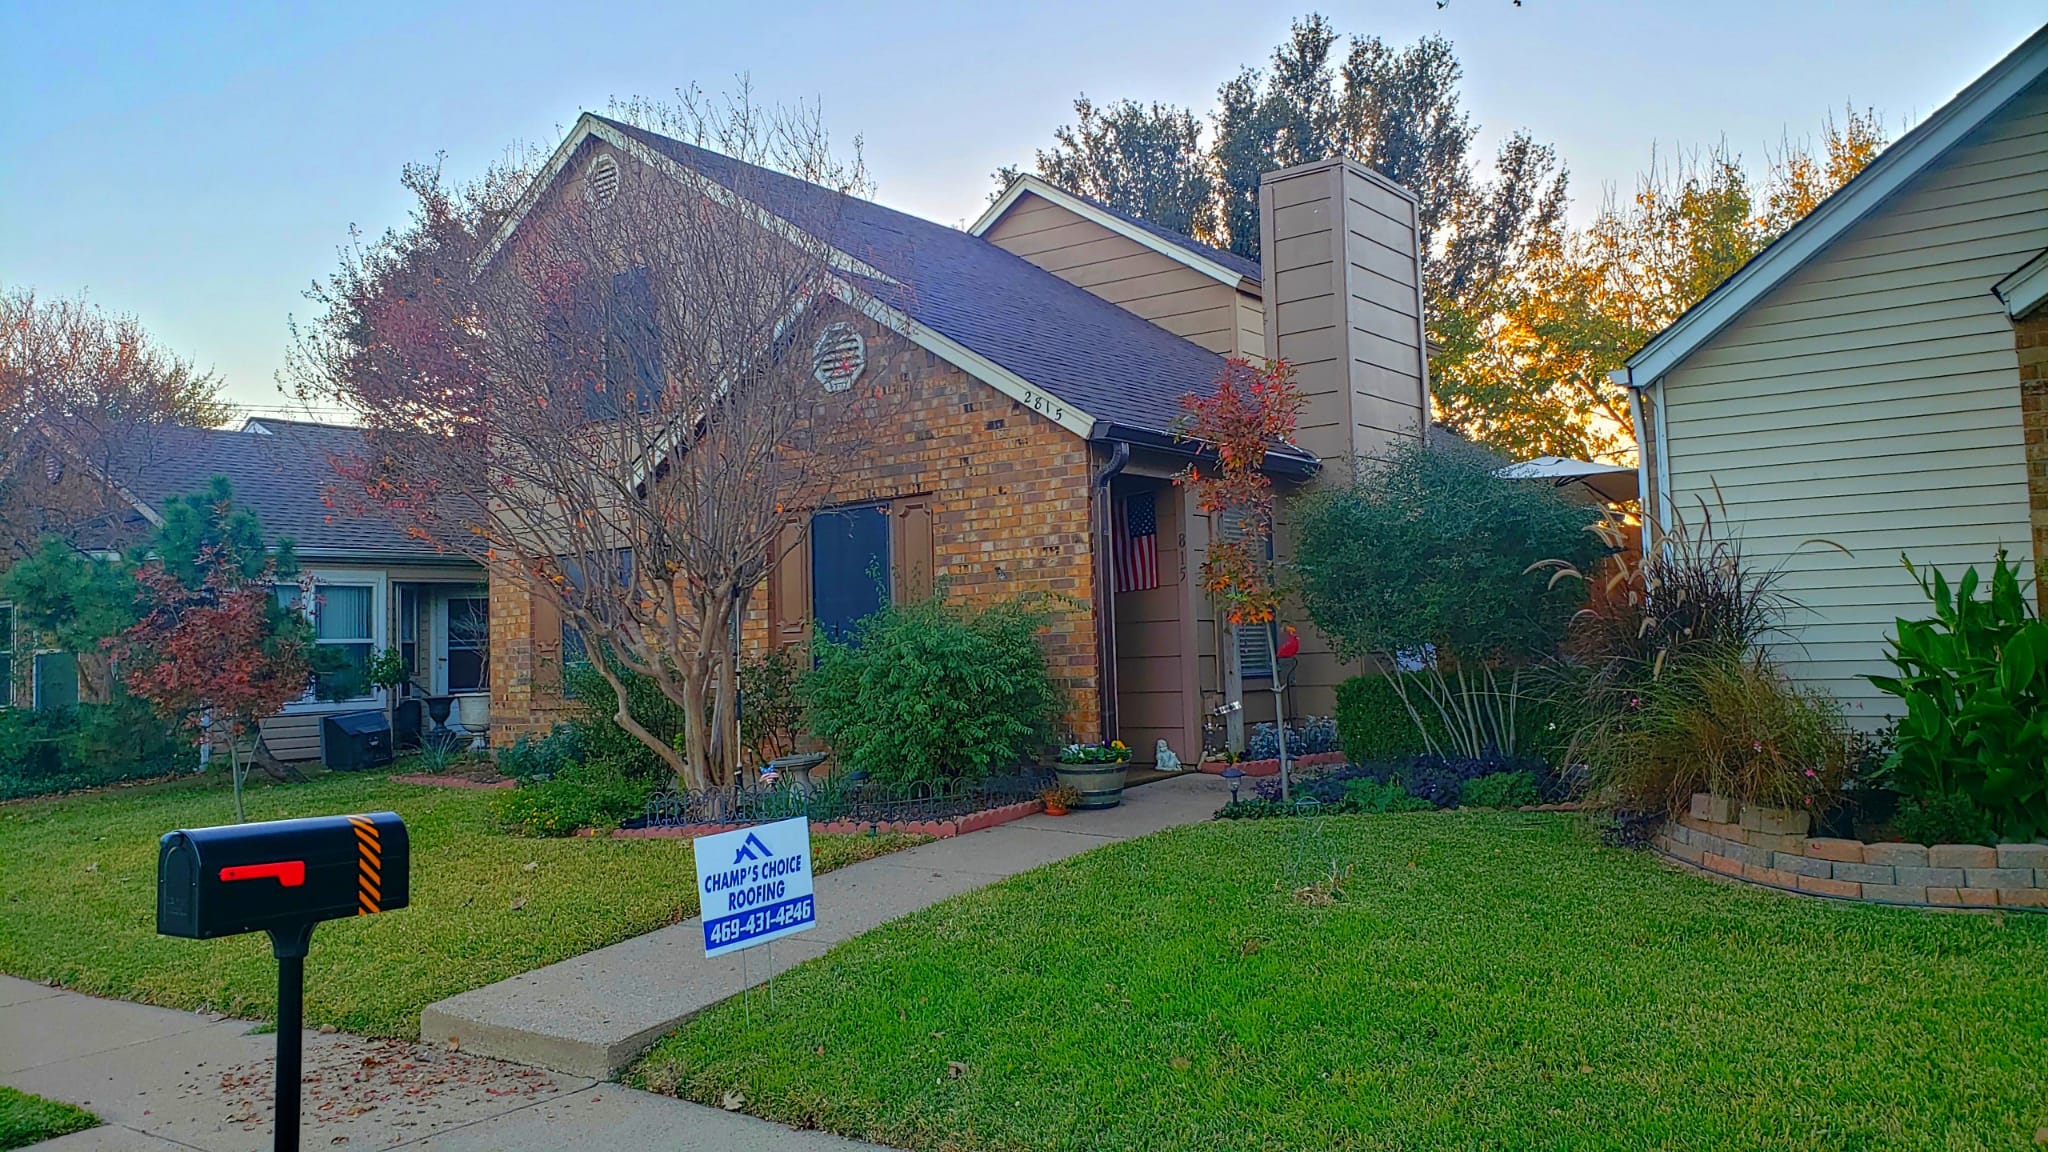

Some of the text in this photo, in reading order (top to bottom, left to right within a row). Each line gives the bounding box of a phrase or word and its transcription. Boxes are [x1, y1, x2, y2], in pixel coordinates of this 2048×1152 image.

[1024, 391, 1063, 421] 2815
[704, 854, 802, 894] CHAMP'S CHOICE
[728, 880, 786, 911] ROOFING
[710, 899, 812, 944] 469-431-4246
